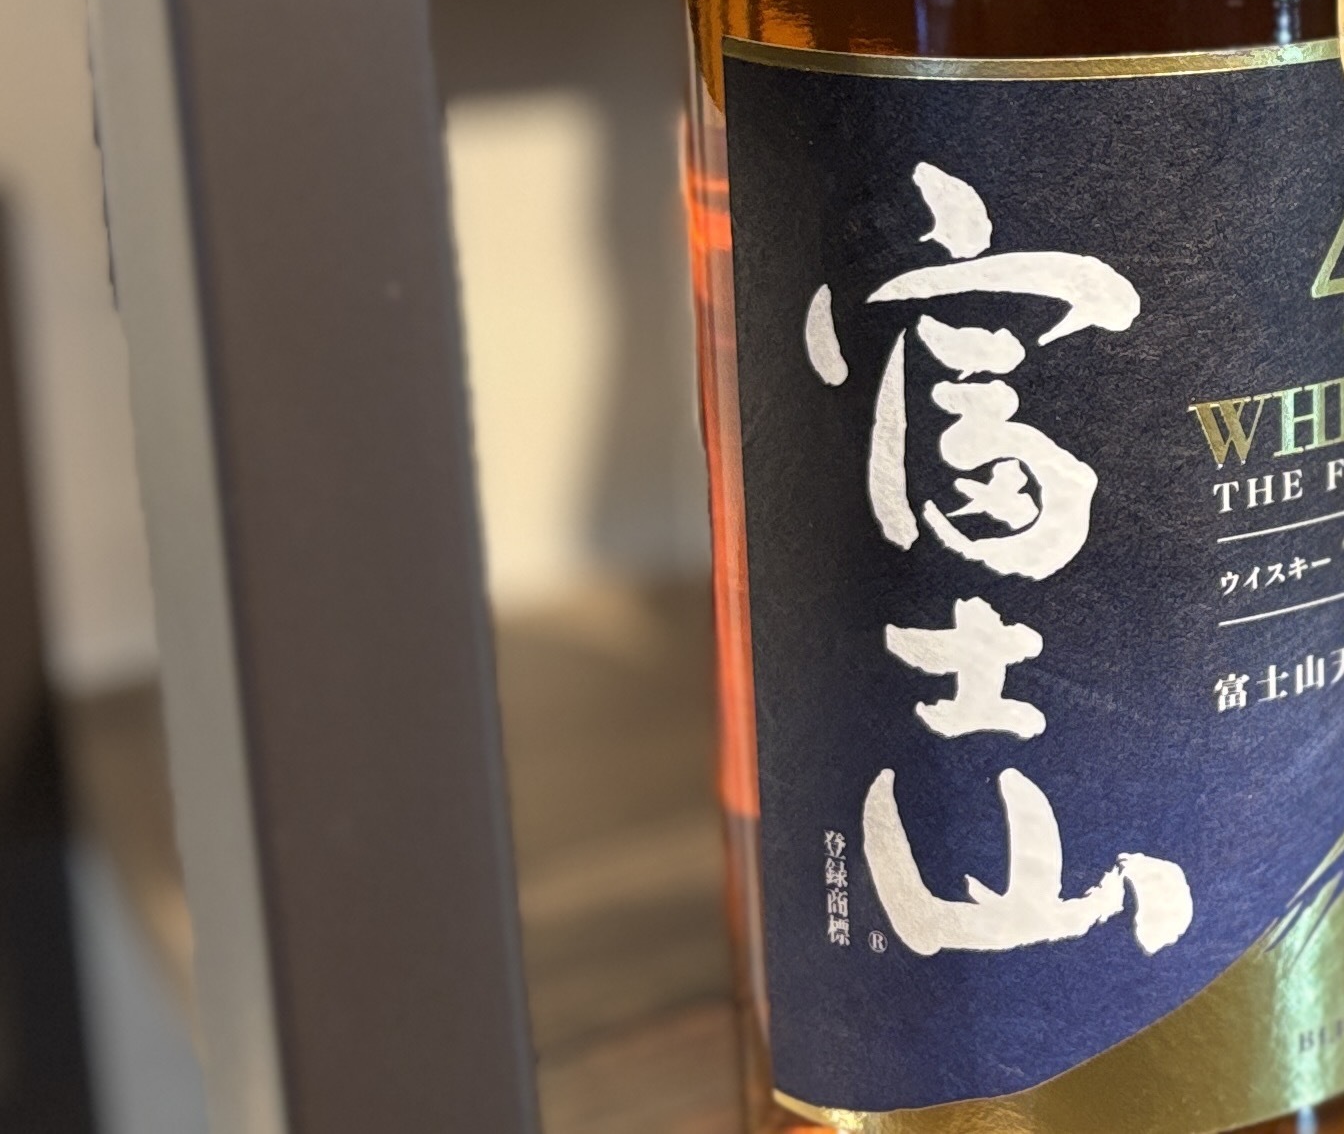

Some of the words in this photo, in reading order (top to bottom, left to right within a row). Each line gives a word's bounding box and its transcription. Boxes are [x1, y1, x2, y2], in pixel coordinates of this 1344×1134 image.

[1212, 468, 1304, 514] THE
[805, 162, 1194, 956] 富士山
[1219, 556, 1332, 596] ウイスキー
[824, 829, 851, 947] 登録商標
